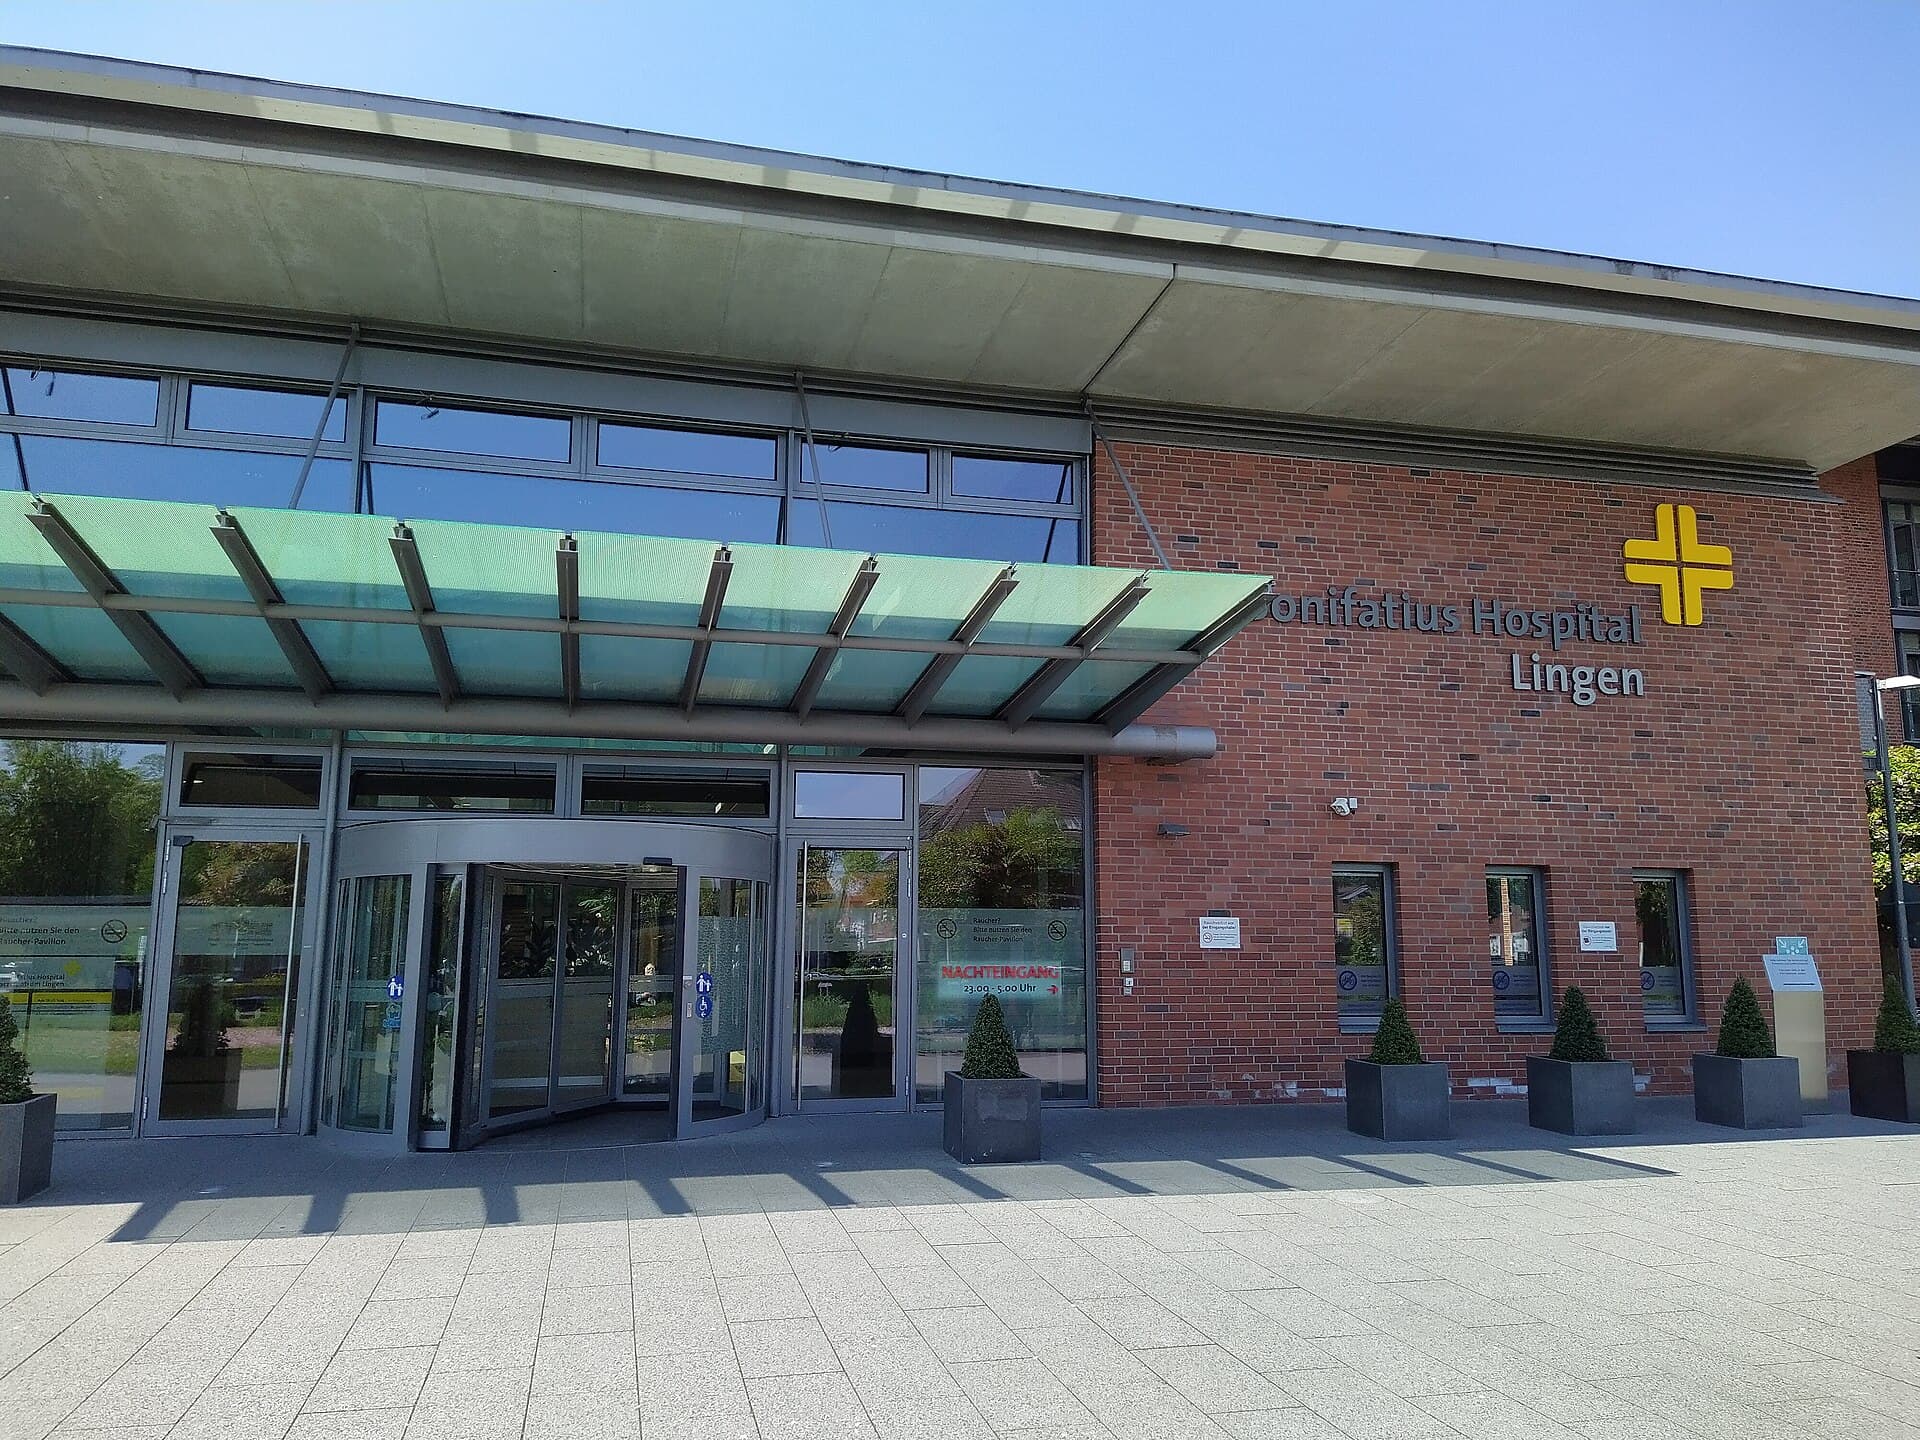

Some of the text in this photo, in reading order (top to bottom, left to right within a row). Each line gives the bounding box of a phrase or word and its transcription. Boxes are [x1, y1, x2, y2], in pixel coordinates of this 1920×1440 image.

[1473, 599, 1641, 651] Hospital
[1511, 652, 1645, 706] Lingen
[50, 926, 63, 934] Sie
[941, 965, 1060, 979] NACHTEINGANG
[964, 984, 990, 994] 23.00
[997, 985, 1018, 994] 5.00
[1020, 983, 1037, 993] Uhr
